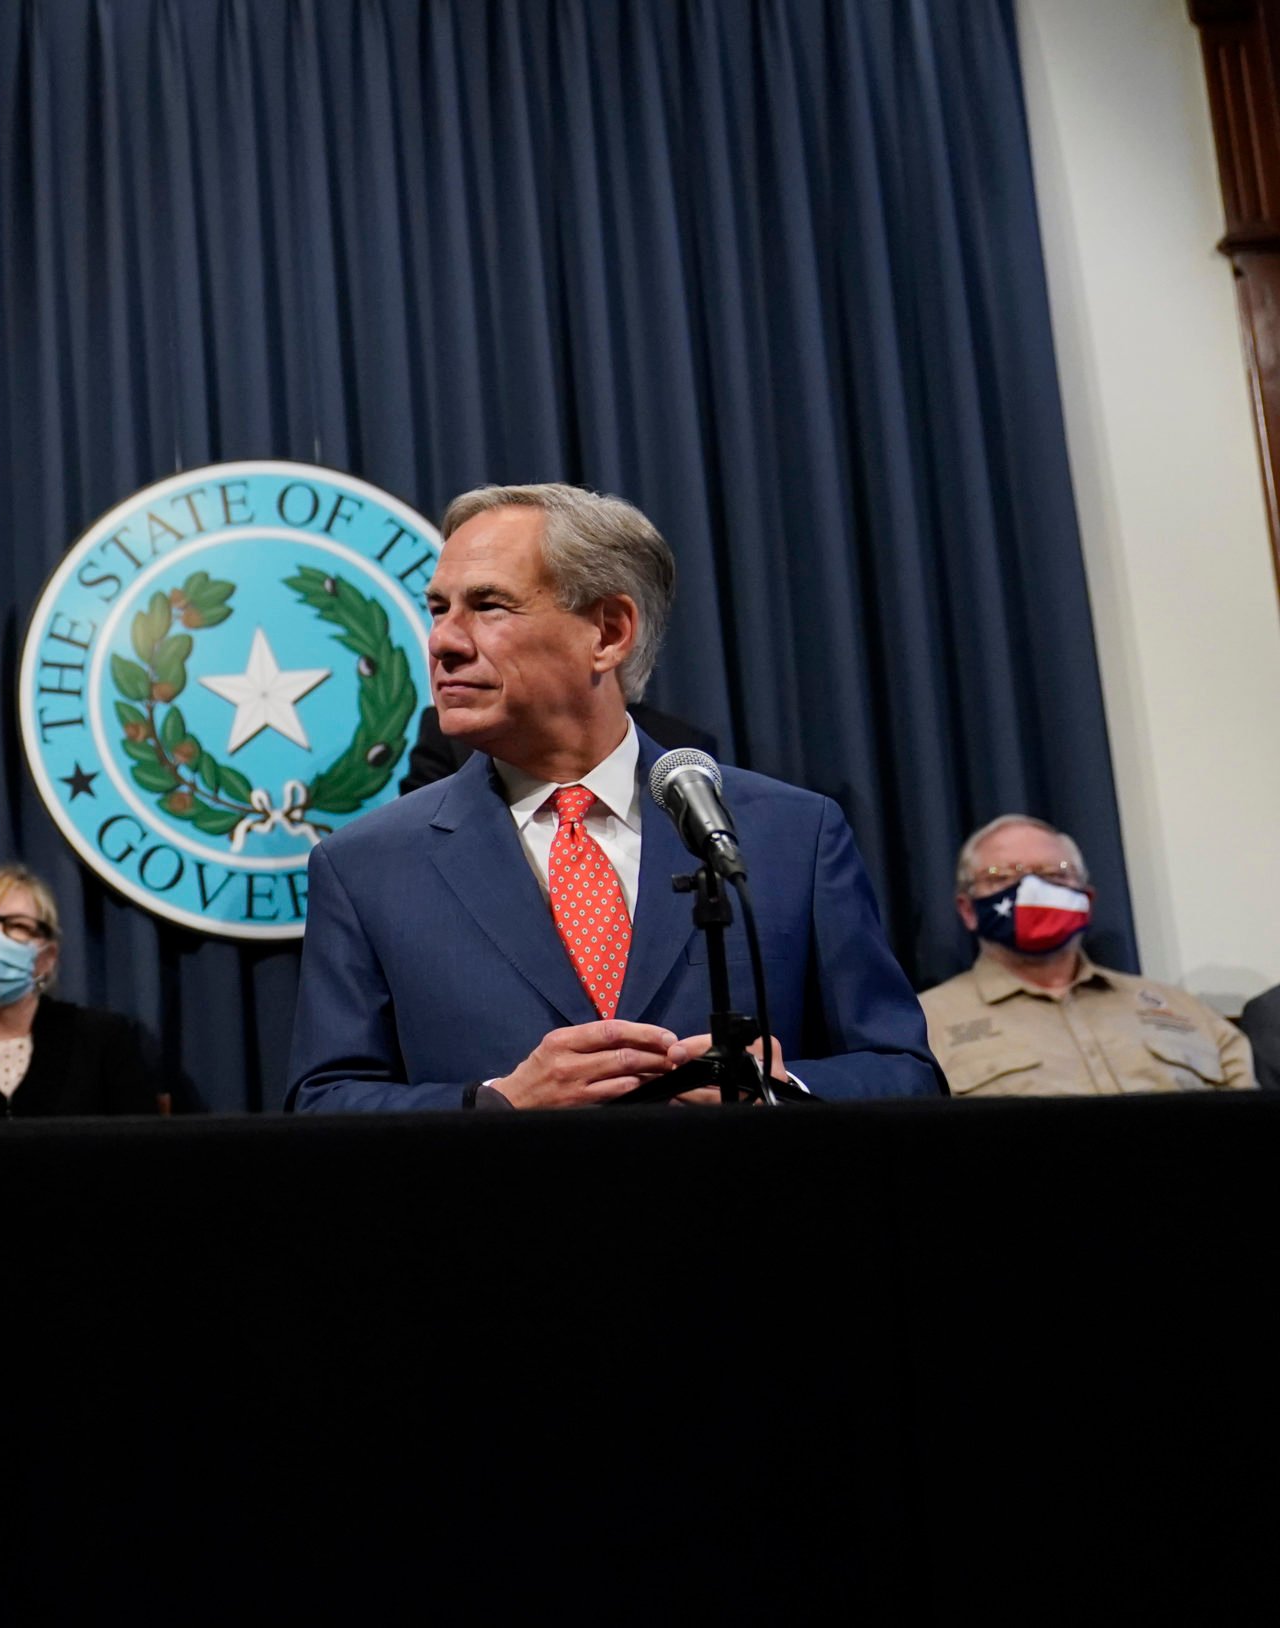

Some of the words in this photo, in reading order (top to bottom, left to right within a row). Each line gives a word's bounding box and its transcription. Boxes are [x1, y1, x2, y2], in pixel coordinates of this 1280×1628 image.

[38, 612, 96, 744] THE
[78, 480, 256, 603] STATE
[276, 481, 364, 535] OF
[371, 518, 438, 611] TE
[97, 815, 308, 921] GOVER
